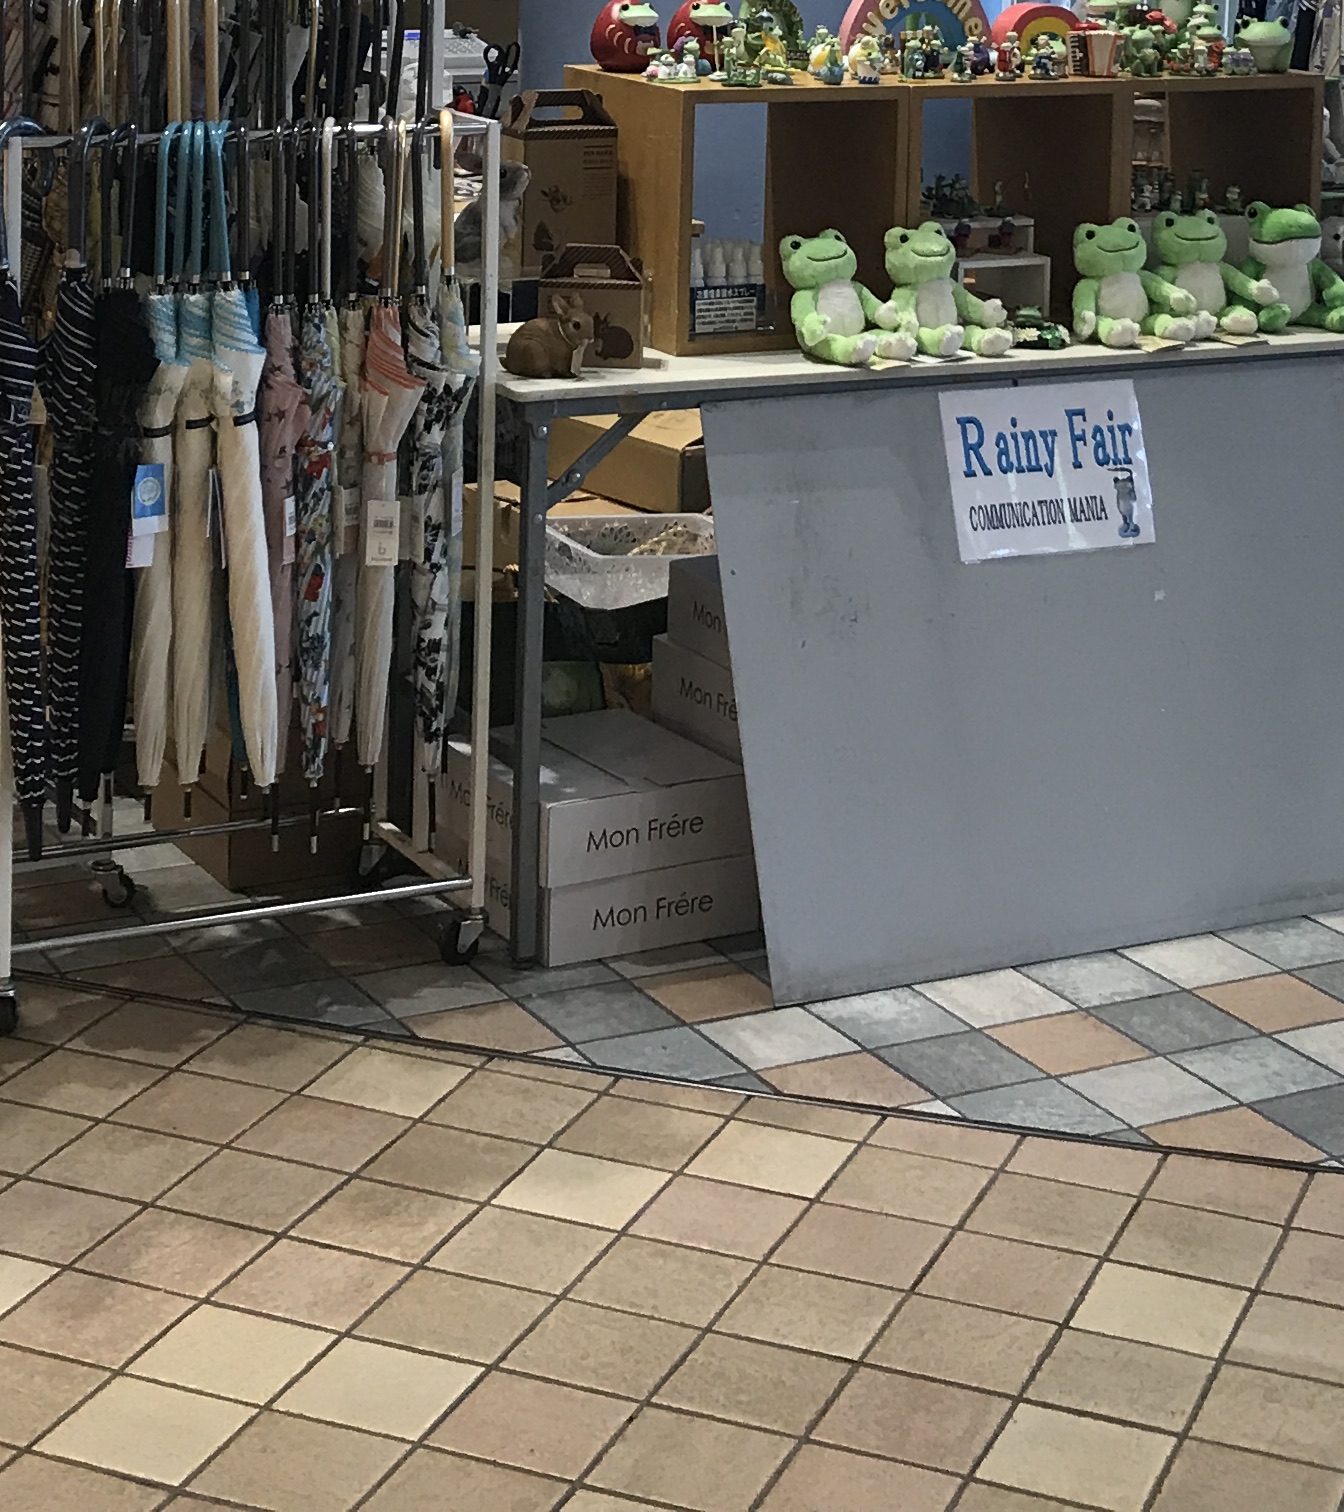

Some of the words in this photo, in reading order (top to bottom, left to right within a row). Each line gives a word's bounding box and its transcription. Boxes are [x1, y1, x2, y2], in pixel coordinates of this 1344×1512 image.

[956, 416, 1058, 478] Rainy
[1064, 408, 1134, 469] Fair
[969, 499, 1066, 533] COMMUNICATION
[1068, 495, 1109, 523] MANIA
[692, 600, 722, 633] Mon
[679, 676, 713, 710] Mon
[586, 826, 640, 853] Mon
[648, 814, 704, 841] Frére
[592, 905, 648, 931] Mon
[656, 892, 714, 921] Frére
